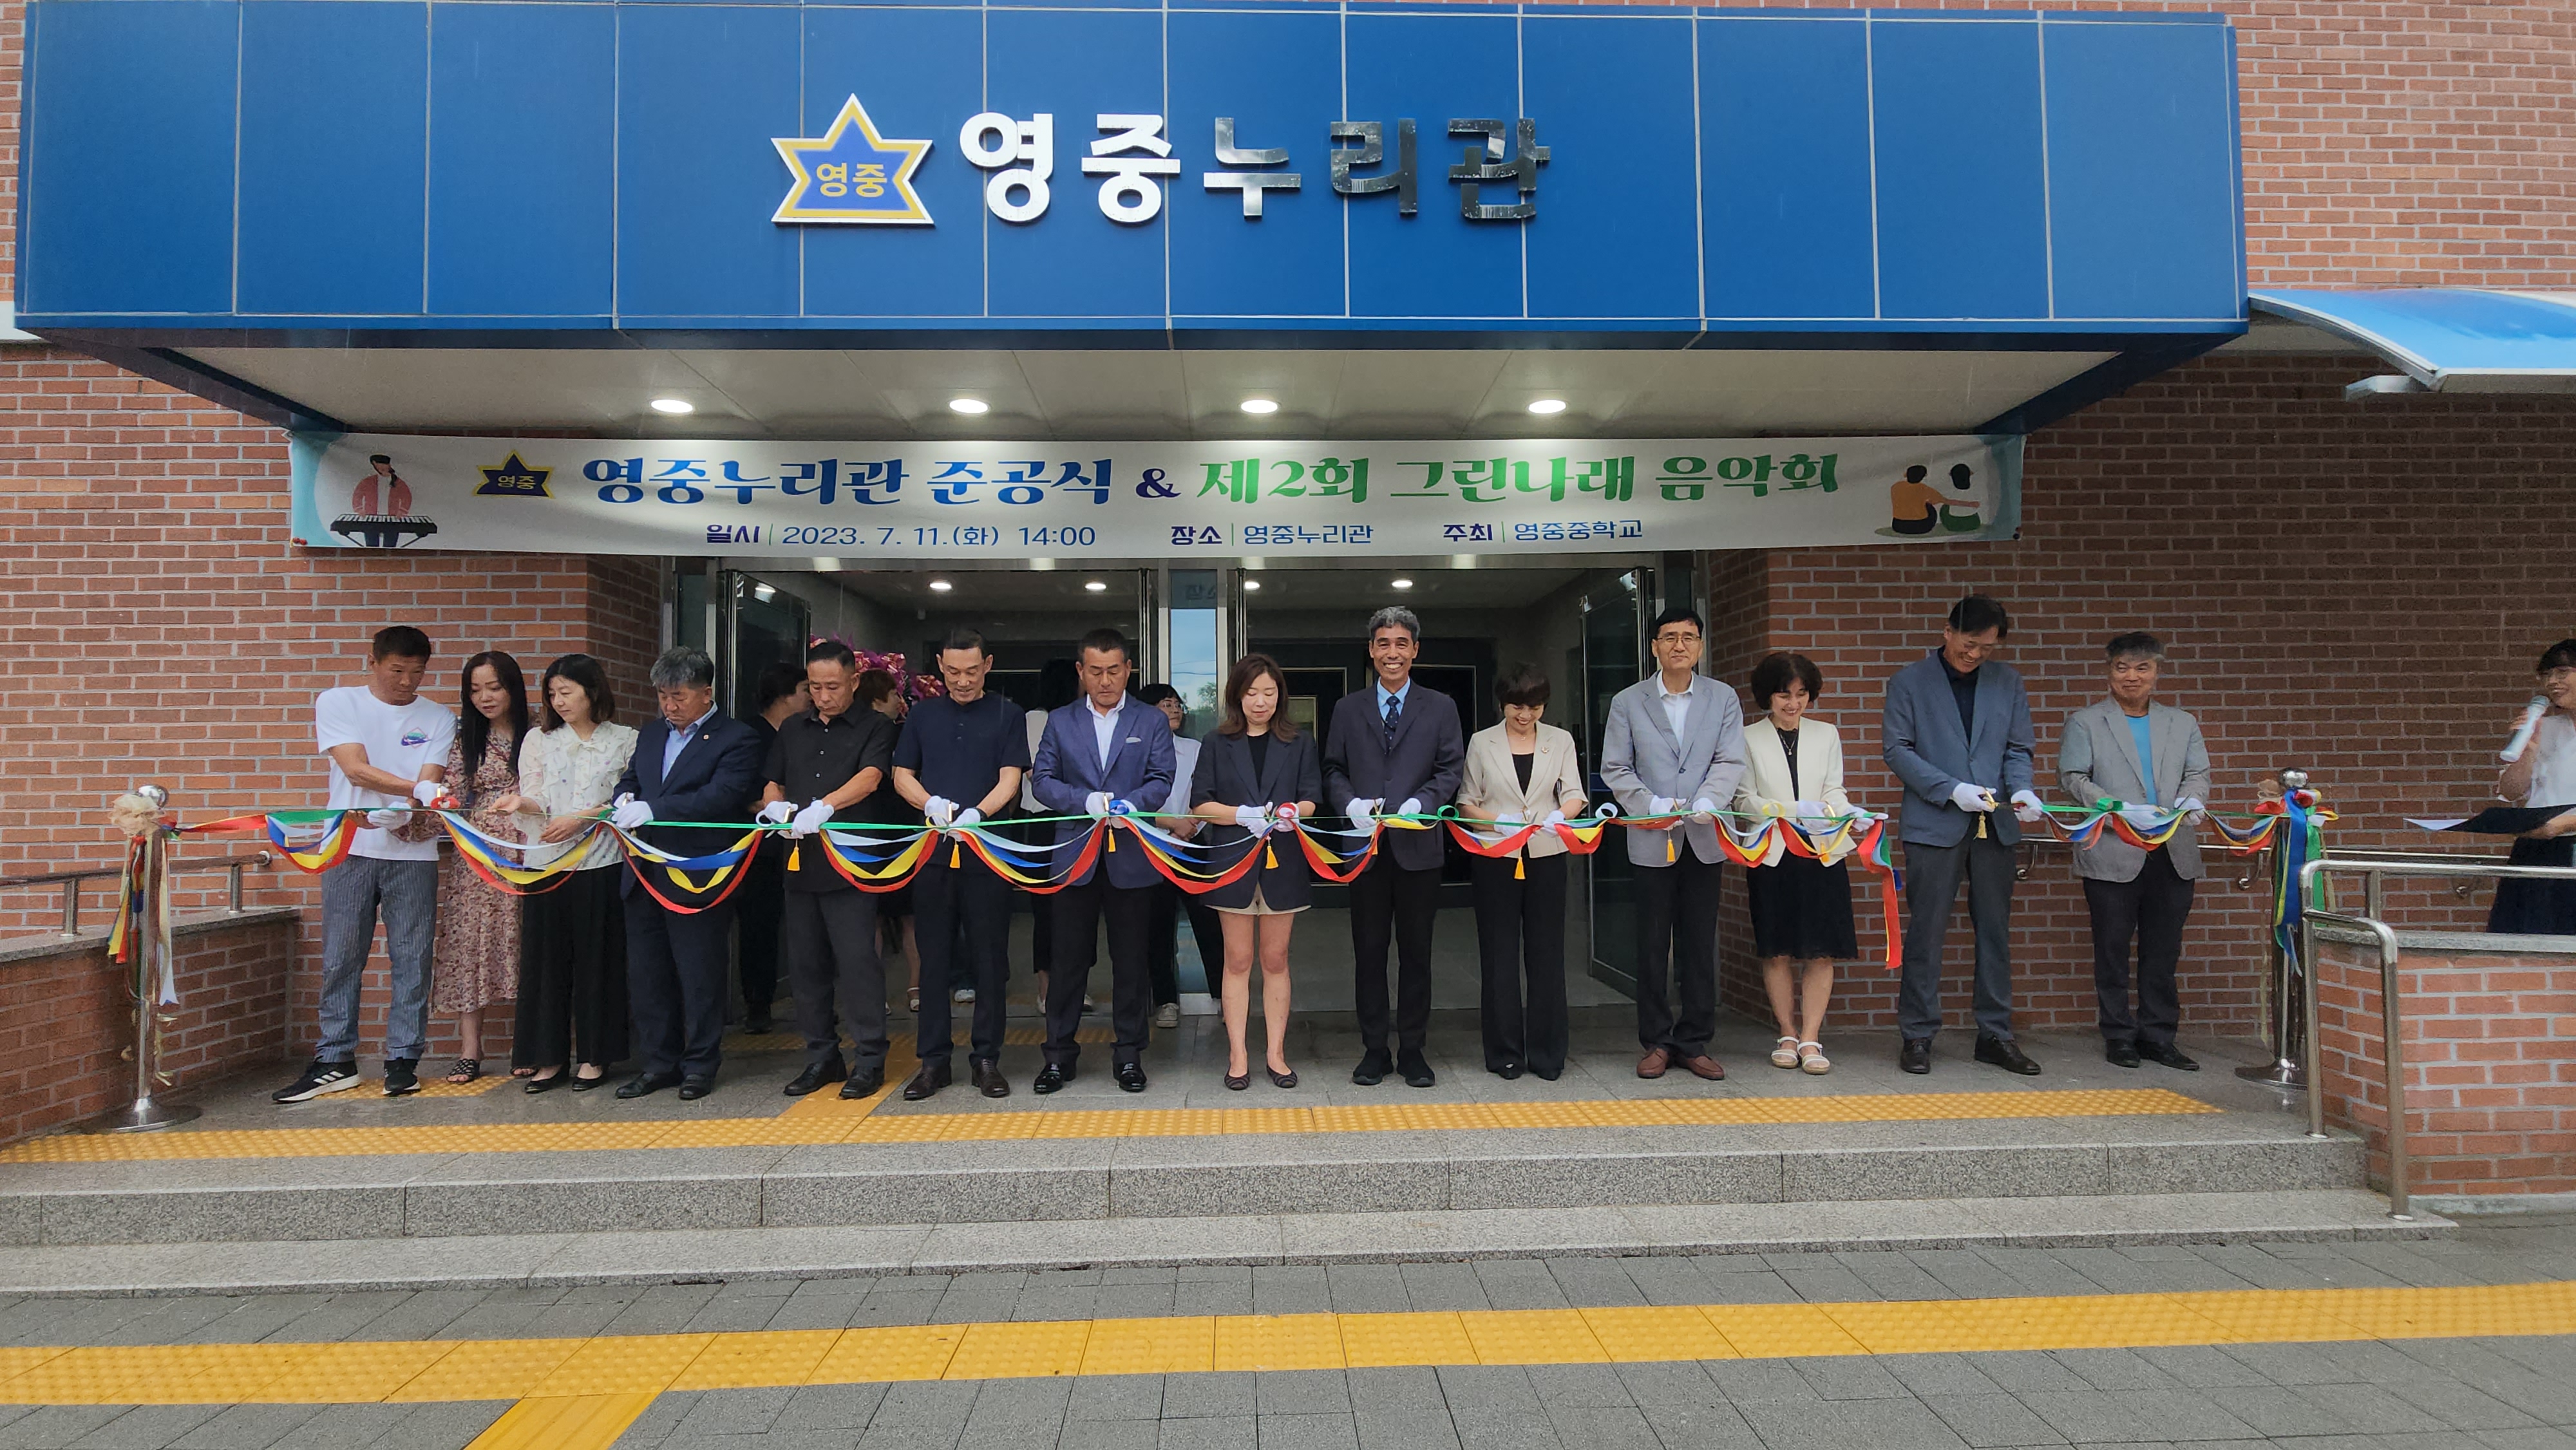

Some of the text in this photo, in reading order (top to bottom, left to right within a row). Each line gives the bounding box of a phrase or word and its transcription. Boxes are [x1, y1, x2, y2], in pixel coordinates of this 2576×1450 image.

[959, 111, 1551, 222] 영중누리관
[816, 161, 886, 198] 영중
[497, 475, 535, 489] 영중
[583, 453, 1839, 505] 영중누리관 준공식 & 제2회 그린나래 음악회
[706, 524, 1096, 547] 일시 2023. 7. 11.(화) 14:00
[1171, 525, 1374, 545] 장소 영중누리관
[1443, 520, 1643, 542] 주최 영중중학교
